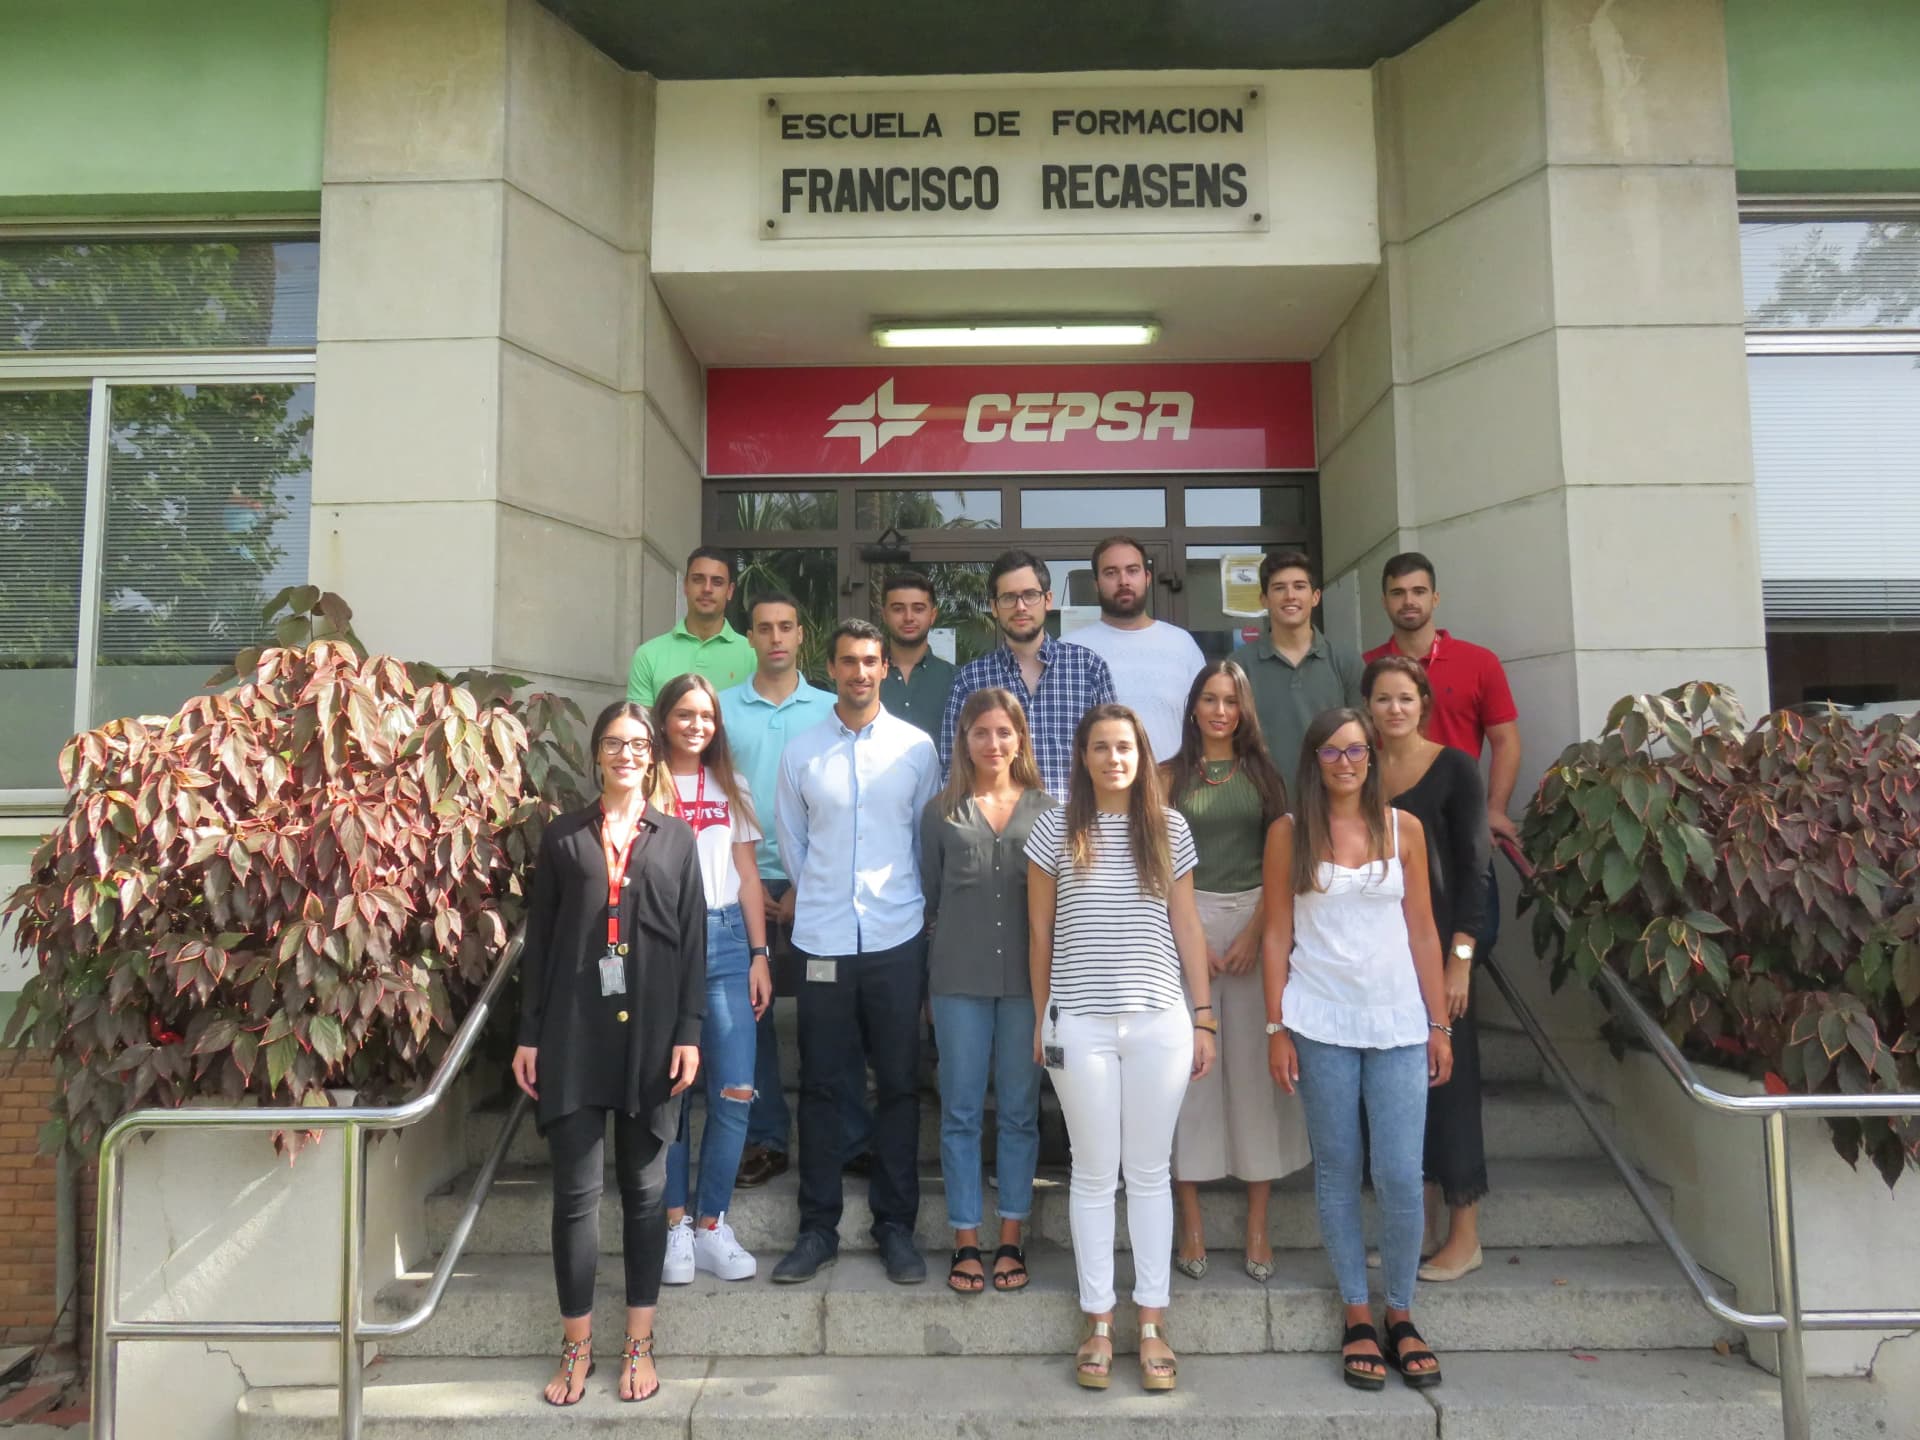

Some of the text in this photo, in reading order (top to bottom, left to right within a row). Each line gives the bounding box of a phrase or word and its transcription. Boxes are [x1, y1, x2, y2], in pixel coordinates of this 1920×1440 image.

[781, 108, 1245, 141] ESCUELA DE FORMACION
[782, 163, 1248, 214] FRANCISCO RECASENS
[963, 391, 1195, 443] CEPSA
